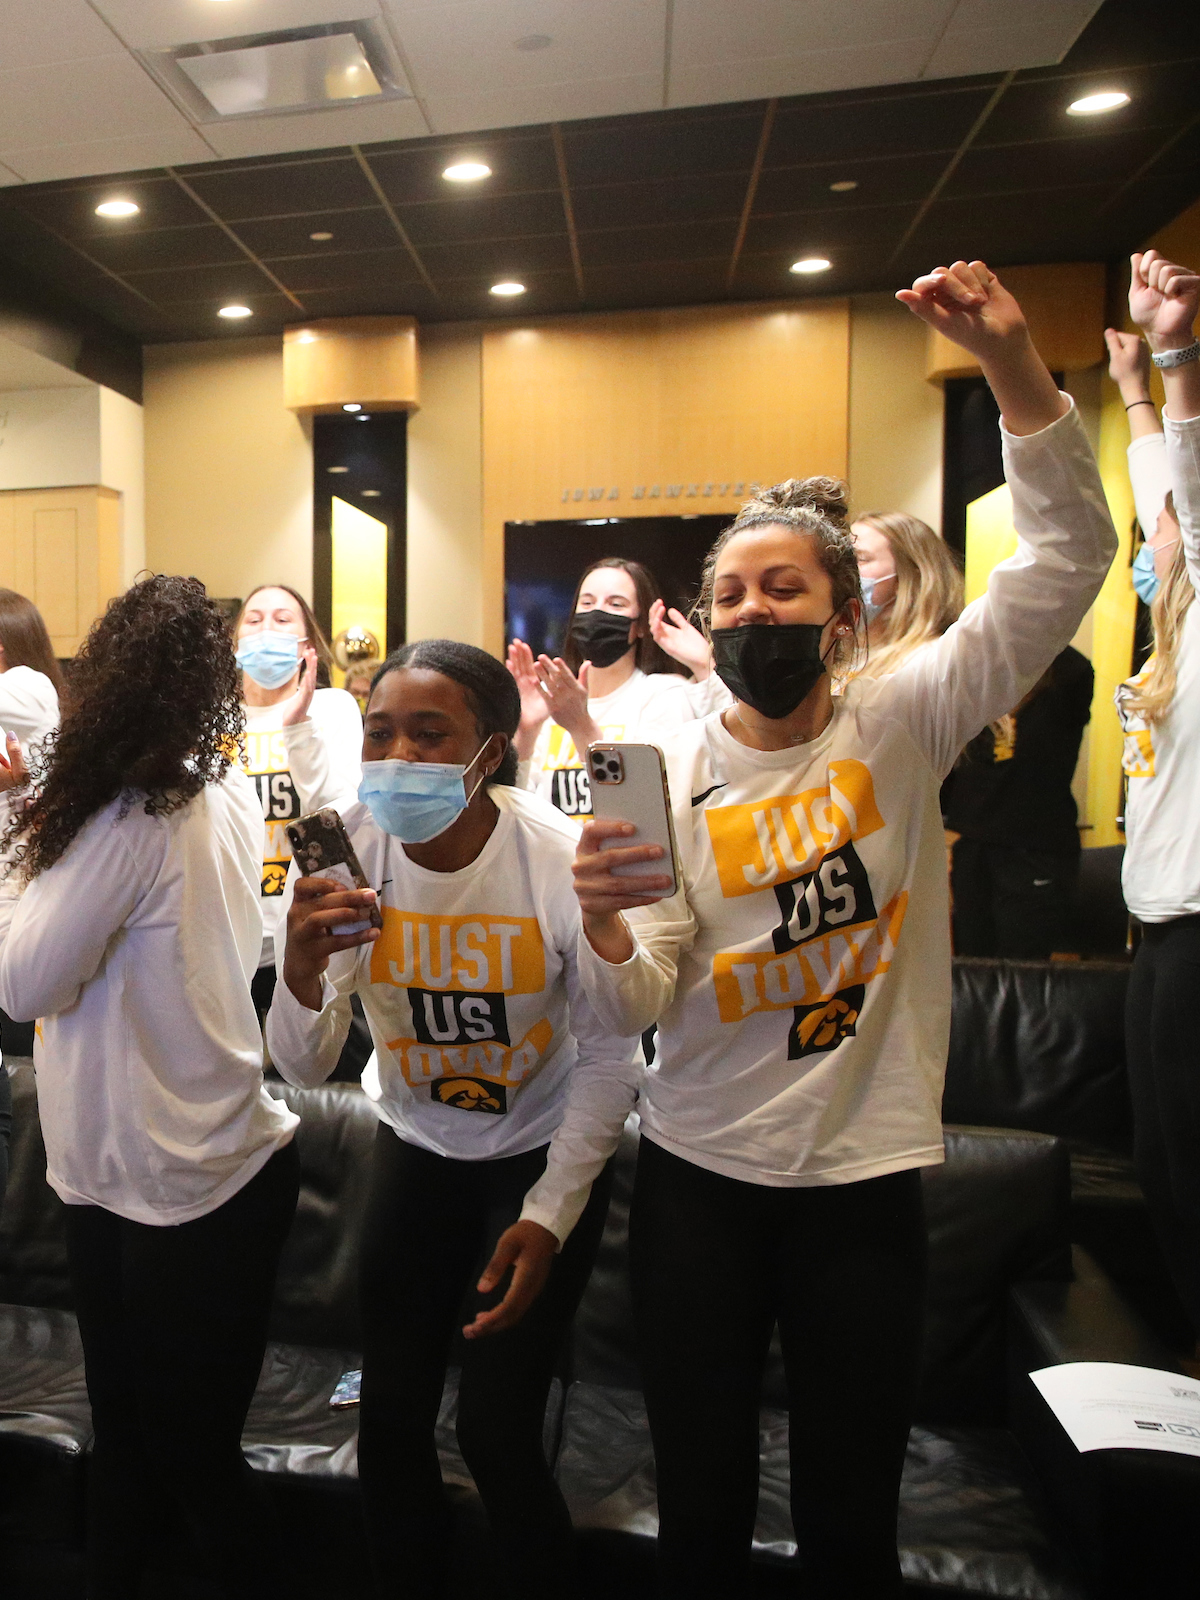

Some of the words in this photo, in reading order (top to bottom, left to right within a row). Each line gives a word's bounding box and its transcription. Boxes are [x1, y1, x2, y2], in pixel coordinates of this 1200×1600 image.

[560, 486, 620, 503] IOWA
[557, 770, 593, 814] US
[787, 855, 857, 943] US
[388, 920, 522, 990] JUST
[422, 993, 497, 1042] US
